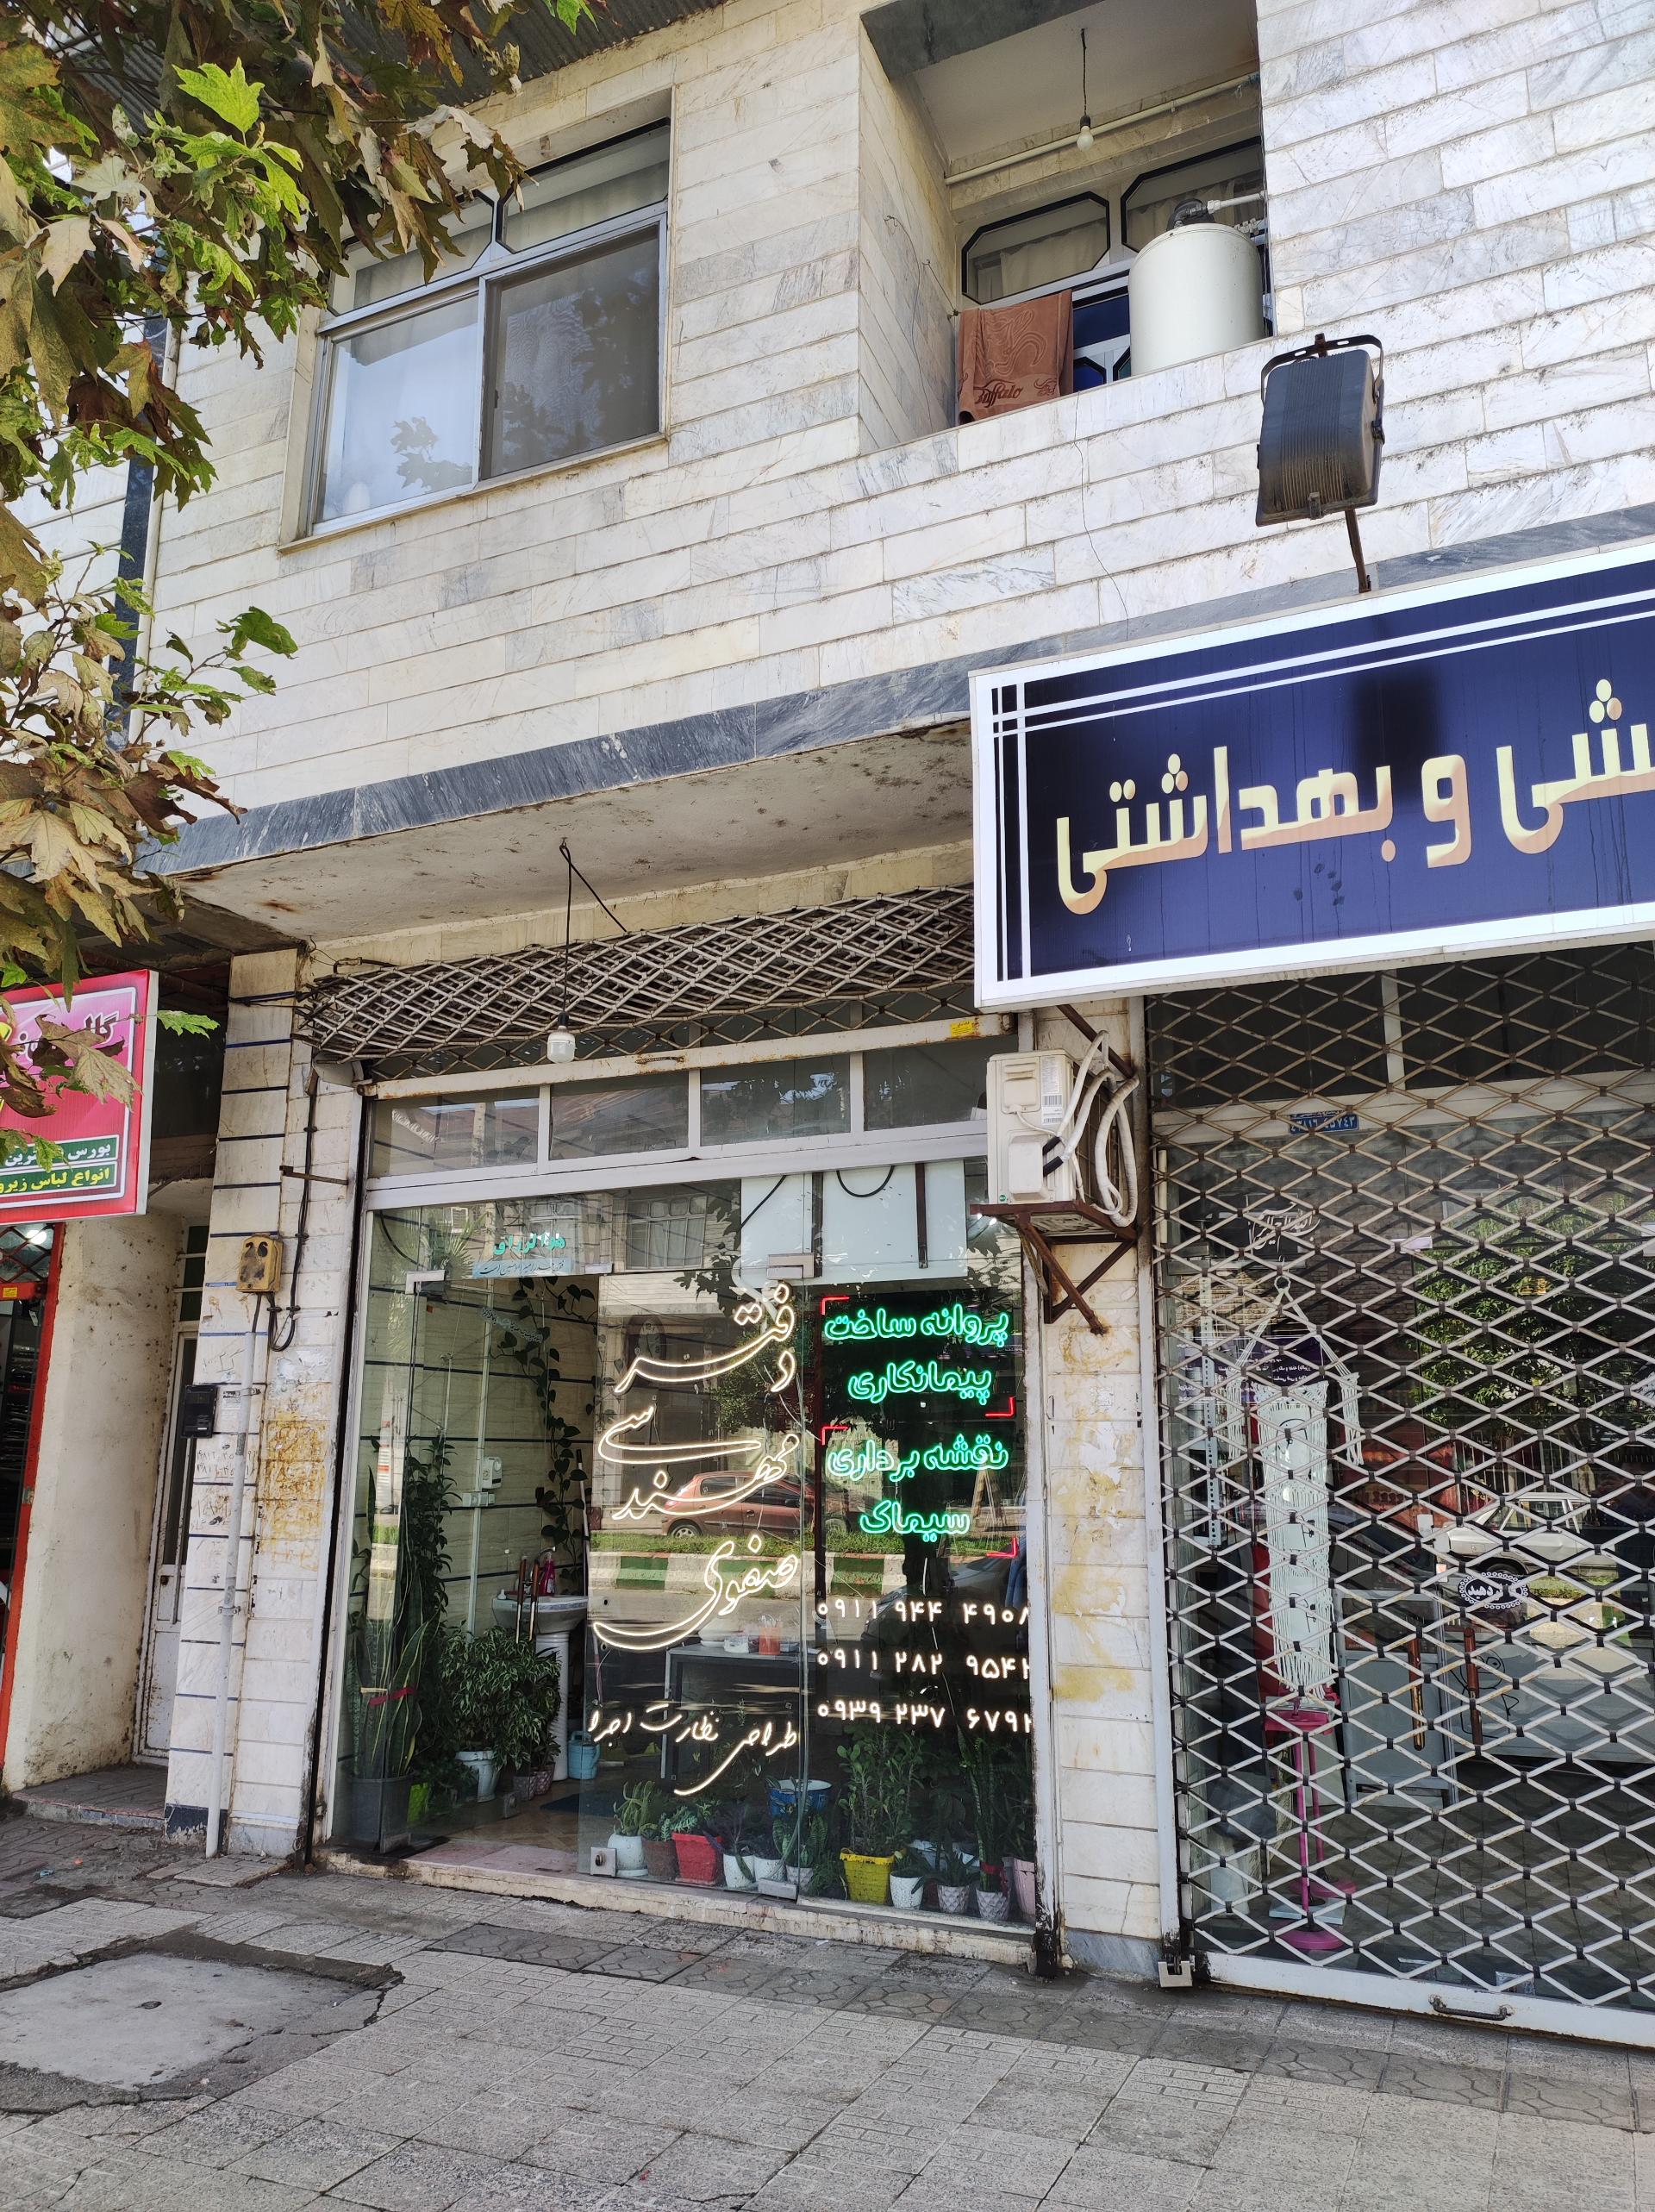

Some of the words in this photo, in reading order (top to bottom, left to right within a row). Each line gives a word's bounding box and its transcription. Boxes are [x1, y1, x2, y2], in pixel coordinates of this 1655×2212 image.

[1496, 678, 1655, 854] شی
[1056, 743, 1396, 915] بهداشتی
[1421, 754, 1472, 868] و
[68, 1142, 111, 1161] بورس
[31, 1170, 68, 1190] لباس
[72, 1167, 110, 1187] انواع
[614, 1283, 796, 1393] دفتر
[824, 1306, 917, 1340] ساخت
[920, 1303, 1009, 1347] پروانه
[846, 1359, 992, 1405] پیمانکاری
[826, 1439, 920, 1481] برداری
[922, 1433, 1009, 1471] نقشه
[859, 1498, 971, 1542] سیماک
[593, 1534, 799, 1651] صفوی
[817, 1597, 877, 1619] ۰۹۱۱
[895, 1600, 943, 1623] ۹۴۴
[817, 1648, 878, 1671] ۰۹۱۱
[895, 1651, 943, 1676] ۲۸۲
[587, 1709, 633, 1747] اجرا
[639, 1703, 720, 1743] نظارت
[817, 1699, 882, 1724] ۰۹۳۹
[895, 1703, 946, 1729] ۲۳۷
[674, 1720, 799, 1796] طراحی
